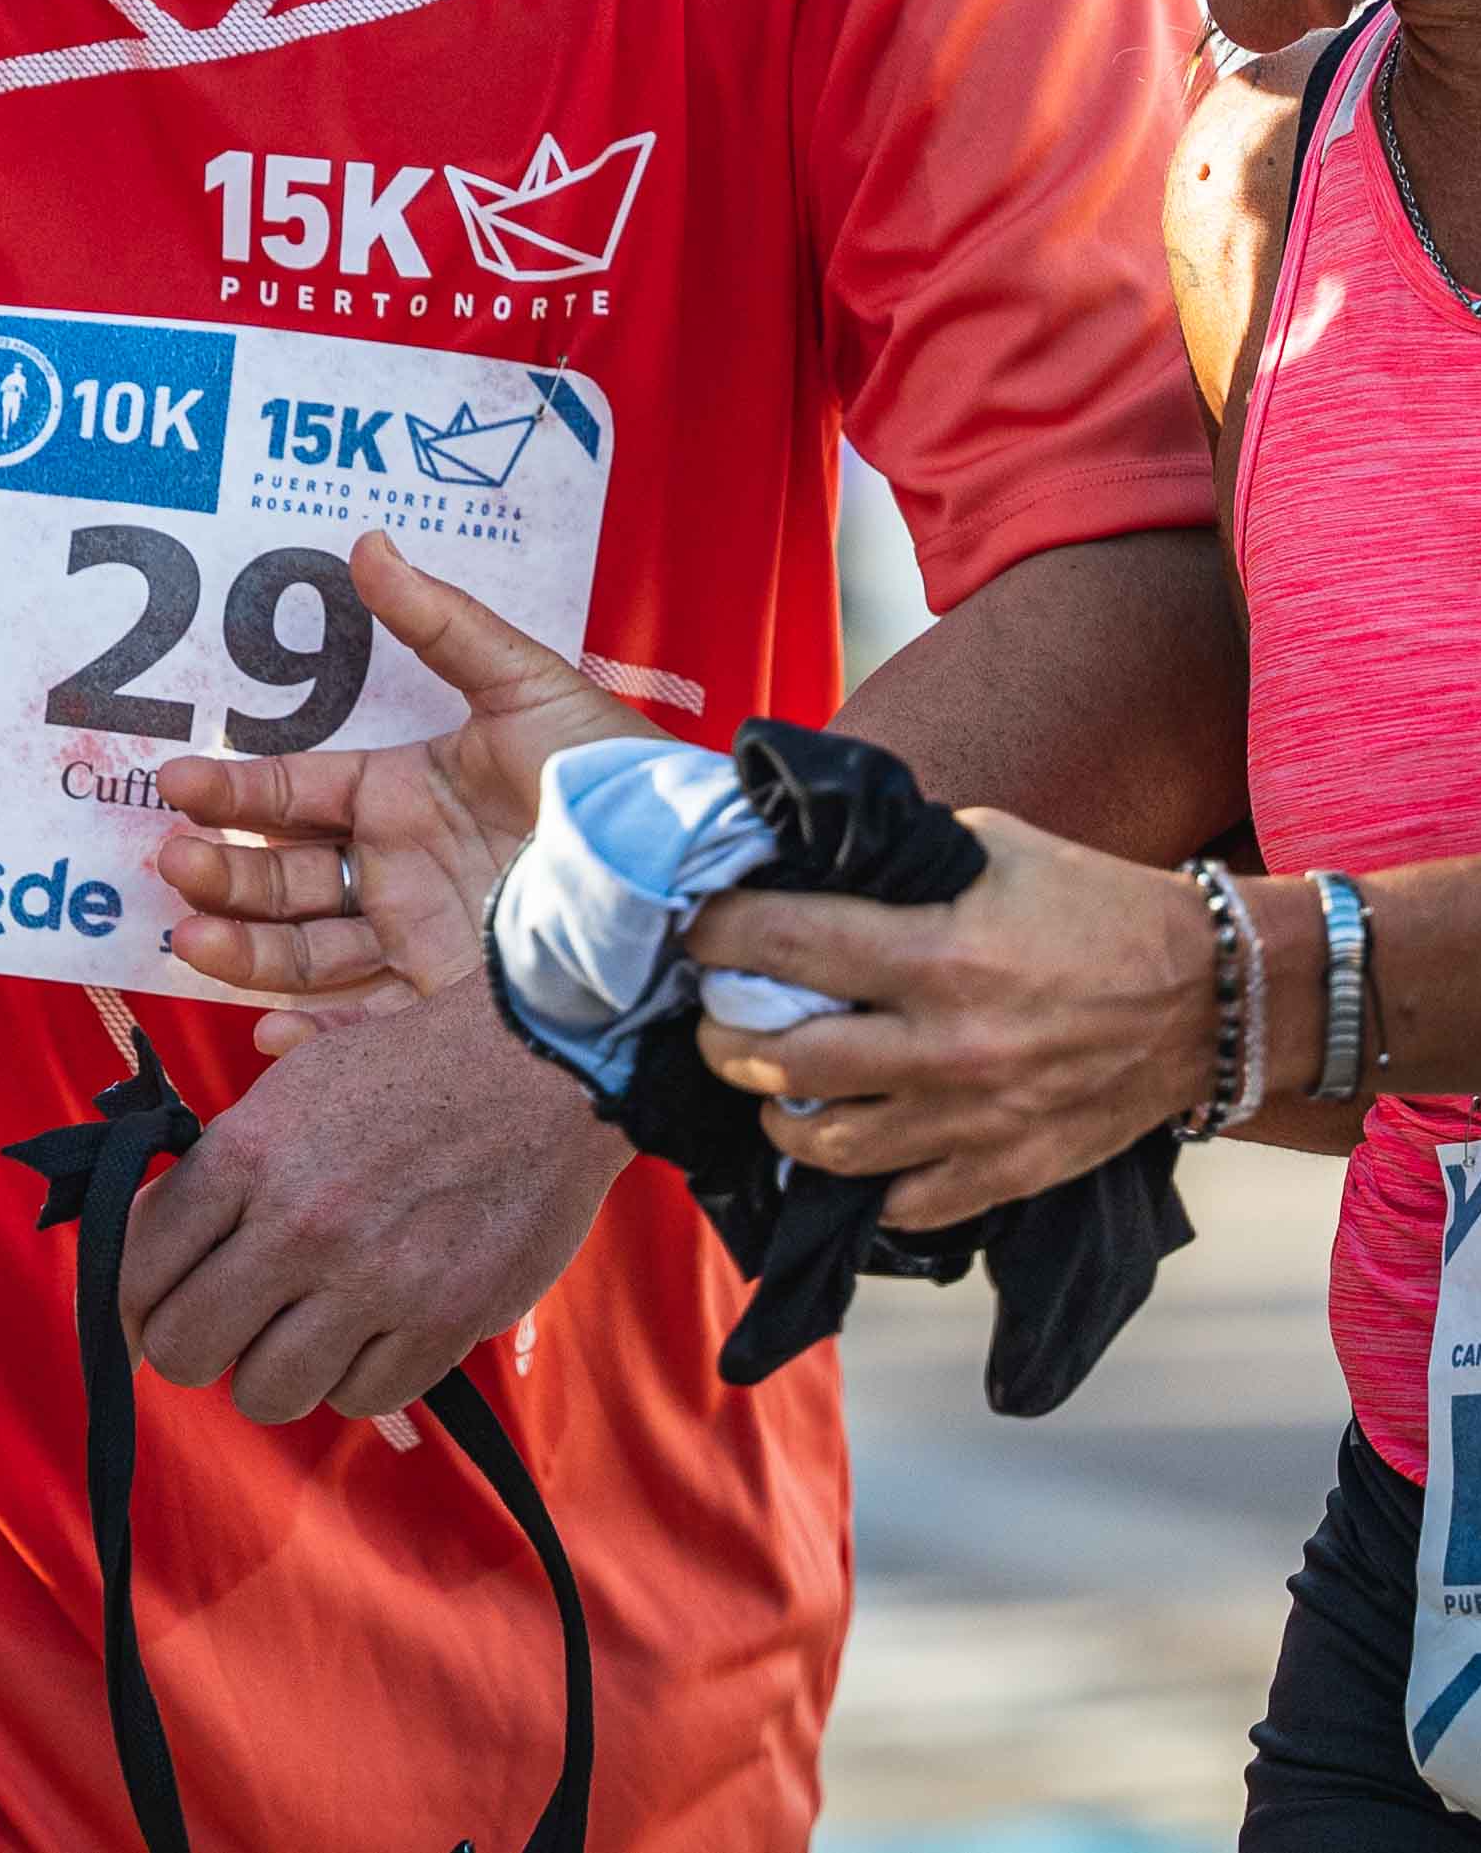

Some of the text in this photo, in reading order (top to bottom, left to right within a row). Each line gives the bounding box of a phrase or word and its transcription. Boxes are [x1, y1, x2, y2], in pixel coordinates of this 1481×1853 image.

[204, 149, 434, 279] 15K
[220, 275, 610, 320] PUERTO NORTE
[73, 379, 205, 452] 10K
[260, 398, 394, 474] 15K
[251, 494, 349, 520] ROSARIO
[384, 512, 406, 528] 12
[419, 515, 445, 533] DE
[457, 519, 522, 544] ABRIL
[253, 472, 351, 498] PUERTO
[368, 487, 448, 511] NORTE
[44, 523, 374, 756] 29
